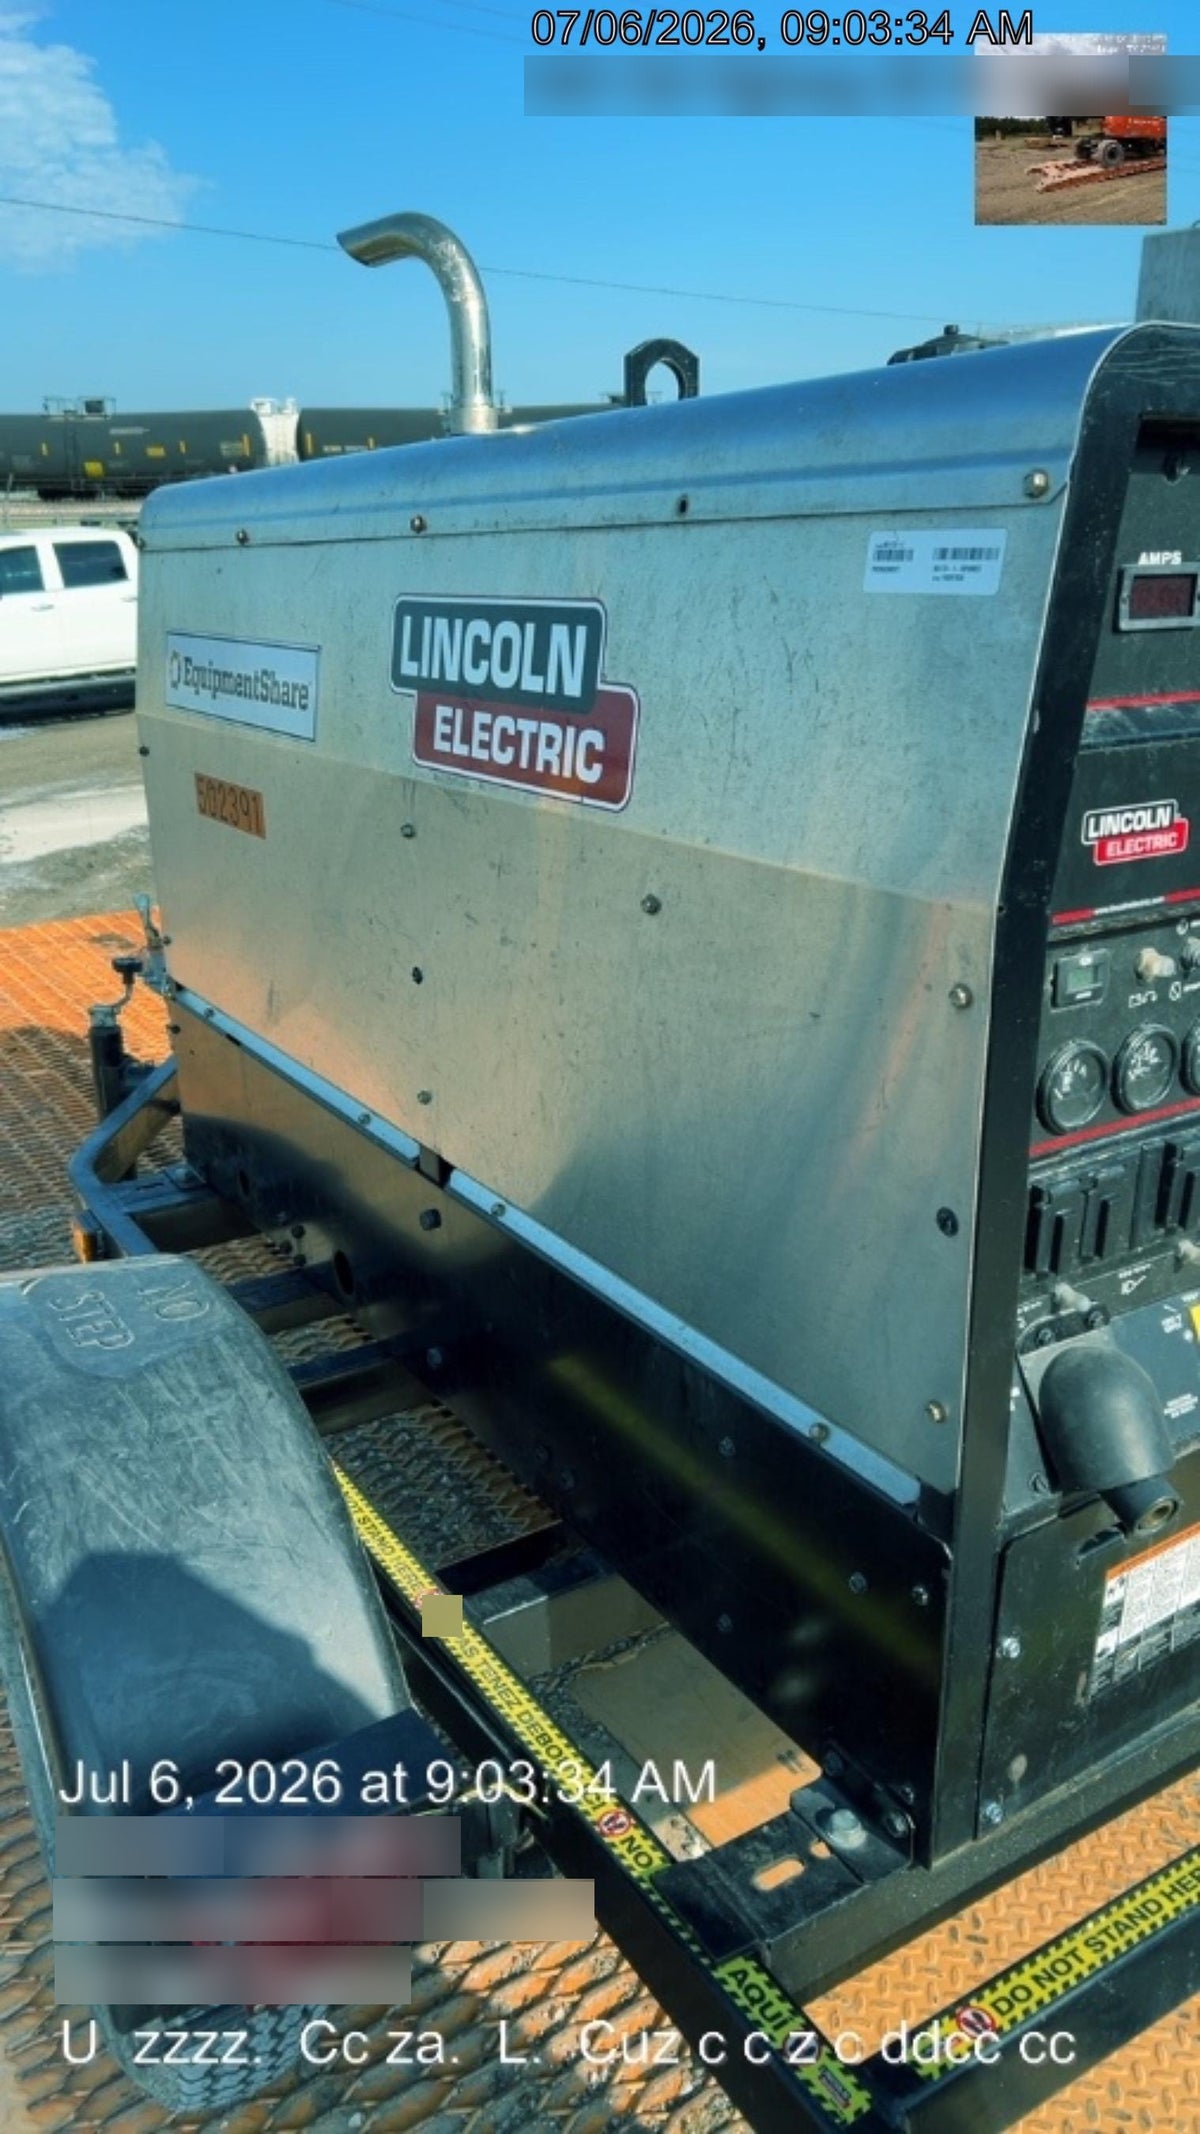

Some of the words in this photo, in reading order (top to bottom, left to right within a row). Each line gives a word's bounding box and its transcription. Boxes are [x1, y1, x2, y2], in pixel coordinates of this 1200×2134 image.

[1138, 550, 1183, 565] AMPS
[183, 655, 310, 711] EquipmentShare
[400, 616, 588, 698] LINCOLN
[433, 704, 605, 784] ELECTRIC
[196, 776, 264, 837] 502391
[1088, 805, 1172, 839] LINCOLN
[1105, 832, 1179, 858] ELECTRIC
[621, 1834, 653, 1870] NO
[991, 1984, 1033, 2016] DO
[1031, 1947, 1086, 1990] NOT
[1083, 1898, 1163, 1951] STAND
